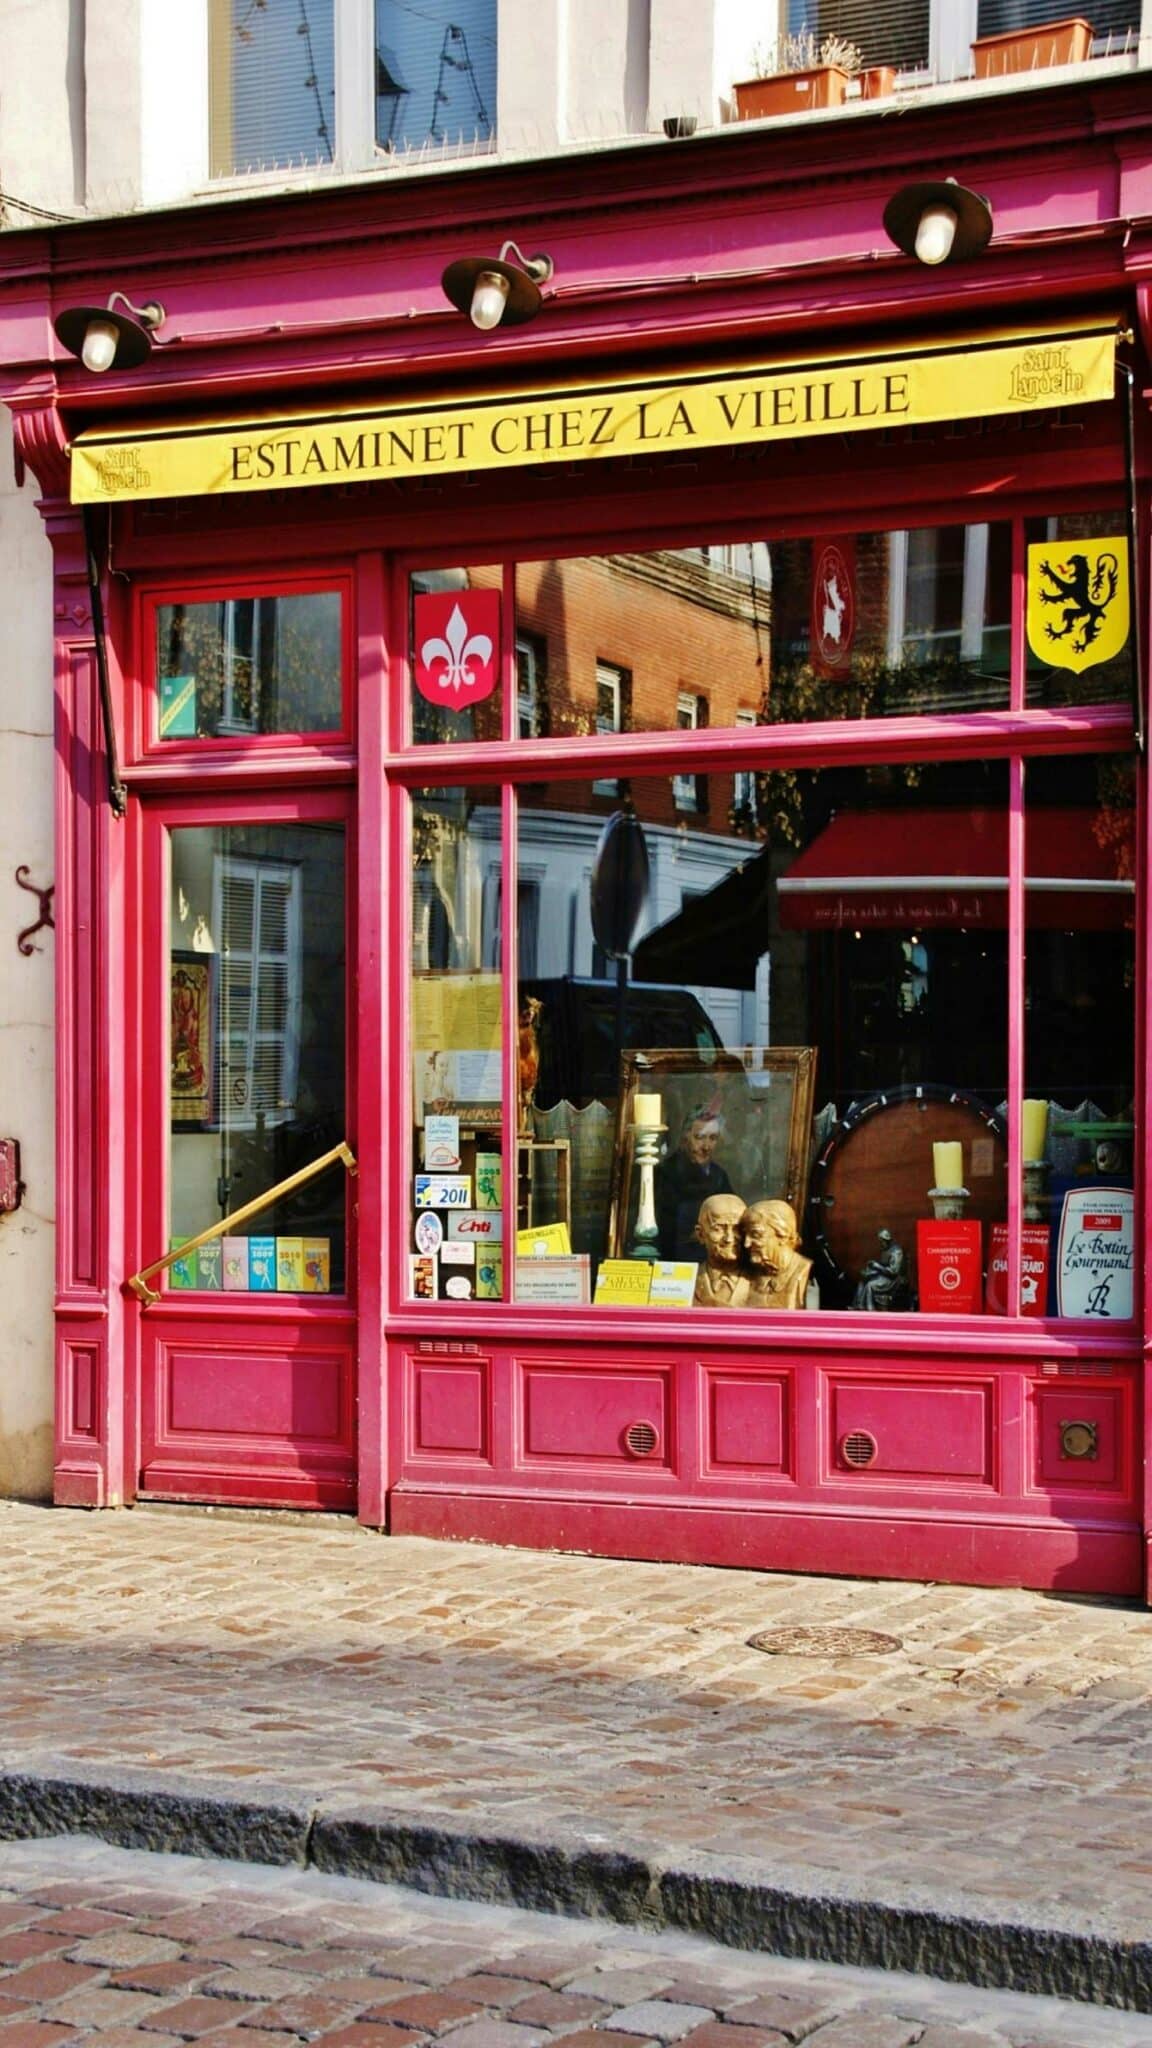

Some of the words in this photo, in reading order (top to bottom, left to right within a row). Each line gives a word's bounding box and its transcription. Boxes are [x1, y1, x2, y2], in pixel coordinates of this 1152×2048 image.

[1022, 345, 1071, 372] Saint
[1008, 364, 1084, 403] Landelin
[230, 422, 475, 481] ESTAMINET
[490, 406, 617, 454] CHEZ
[636, 400, 698, 441] LA
[716, 373, 912, 430] VIEILLE
[104, 446, 141, 469] Saint
[440, 1188, 468, 1204] 2011
[926, 1247, 972, 1255] CHAMPERARD
[1067, 1231, 1086, 1253] Le
[1088, 1233, 1135, 1256] Bottin
[939, 1256, 960, 1264] 2011
[1063, 1253, 1135, 1276] Gourmand
